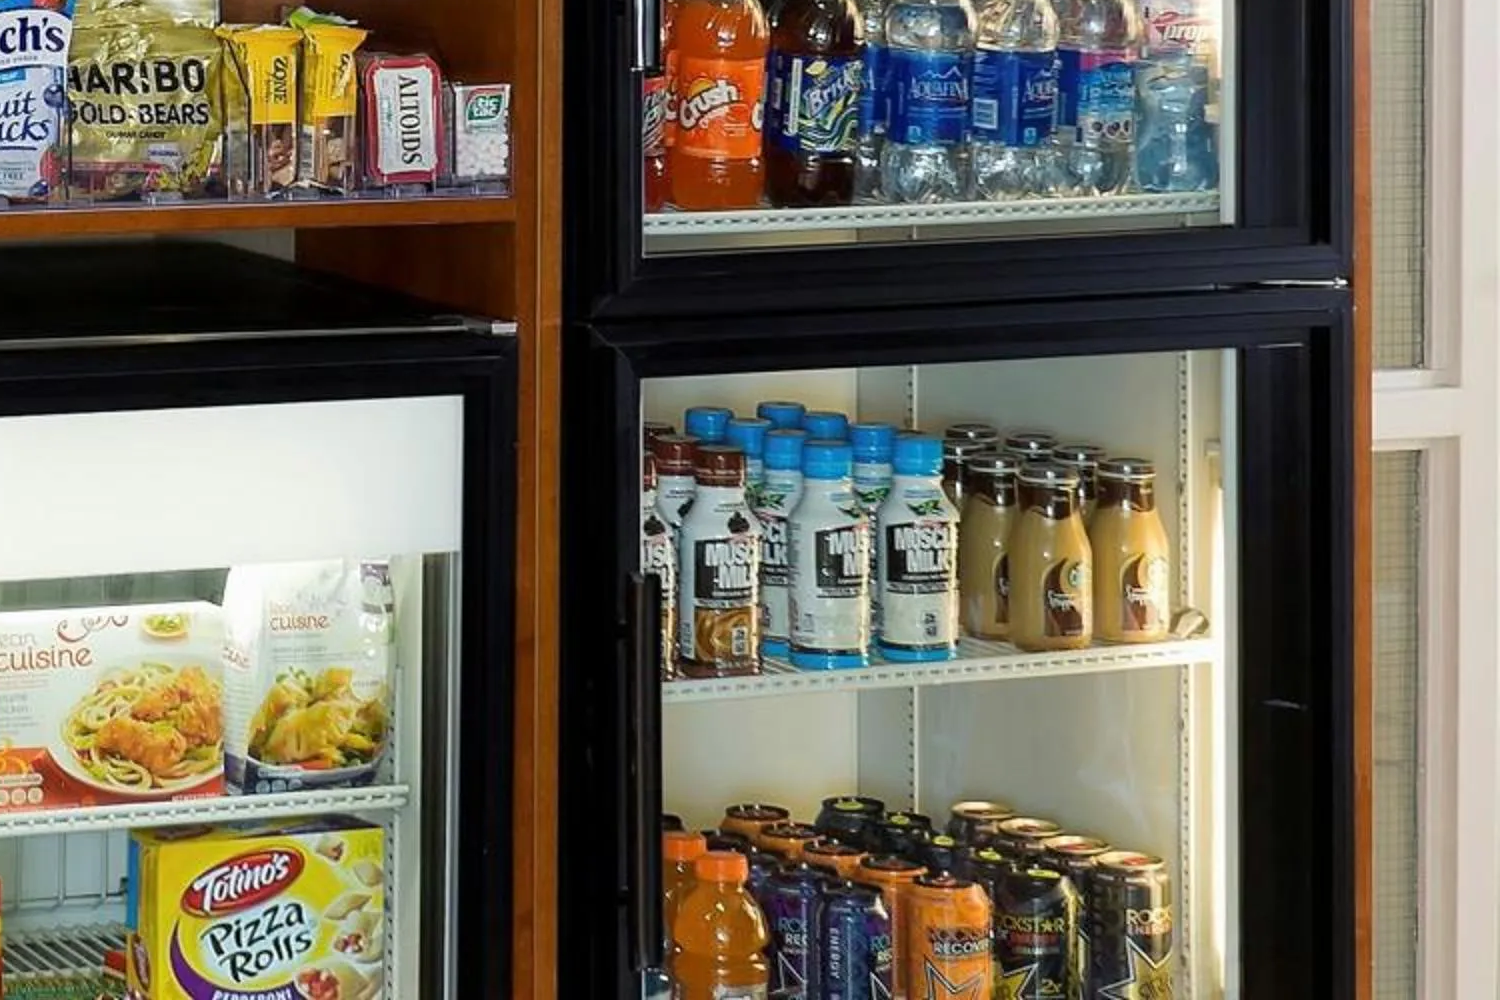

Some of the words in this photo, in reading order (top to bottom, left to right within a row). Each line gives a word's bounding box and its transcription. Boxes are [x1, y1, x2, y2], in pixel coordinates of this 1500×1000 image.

[67, 57, 206, 96] HARIBO
[399, 75, 423, 165] ALTOIDS
[678, 79, 741, 131] Crush
[269, 612, 331, 632] cuisine
[193, 852, 292, 913] Totino's
[199, 901, 306, 957] Pizza
[218, 929, 313, 983] Rolls
